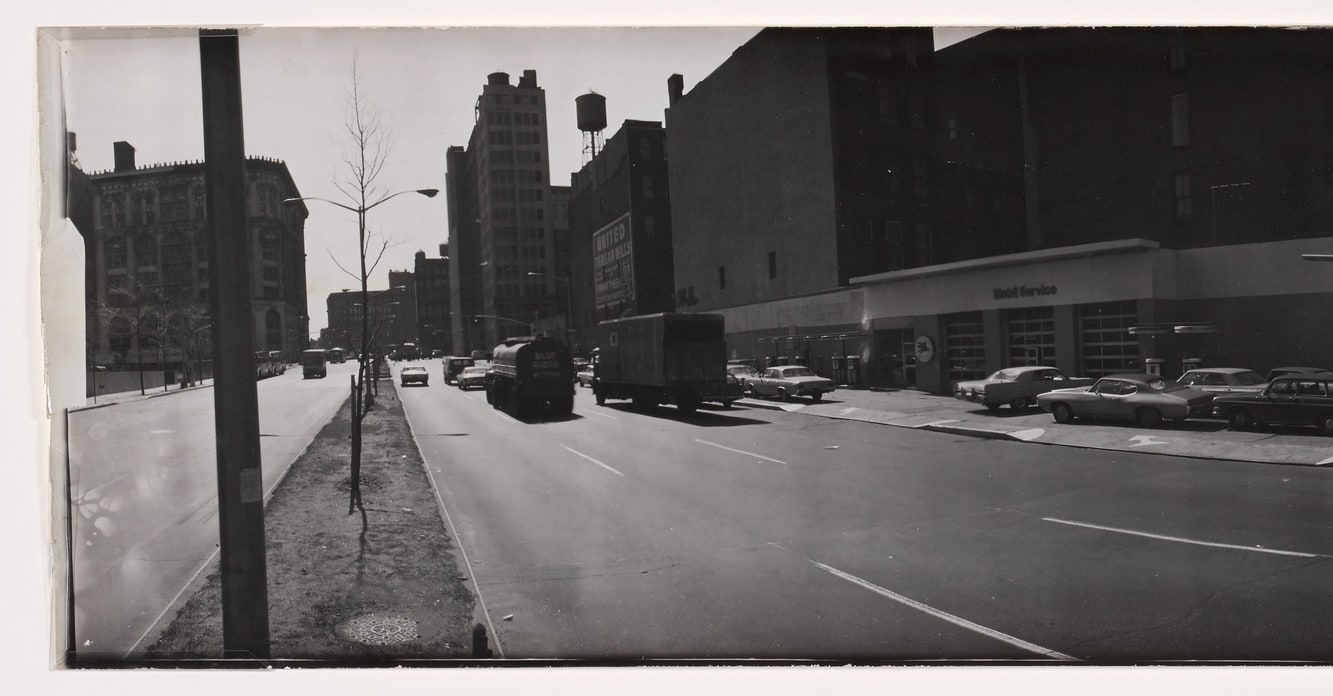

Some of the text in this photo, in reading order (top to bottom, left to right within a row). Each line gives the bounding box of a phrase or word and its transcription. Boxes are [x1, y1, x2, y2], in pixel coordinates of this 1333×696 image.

[597, 223, 625, 252] UNITED
[993, 284, 1057, 300] Mobil Service
